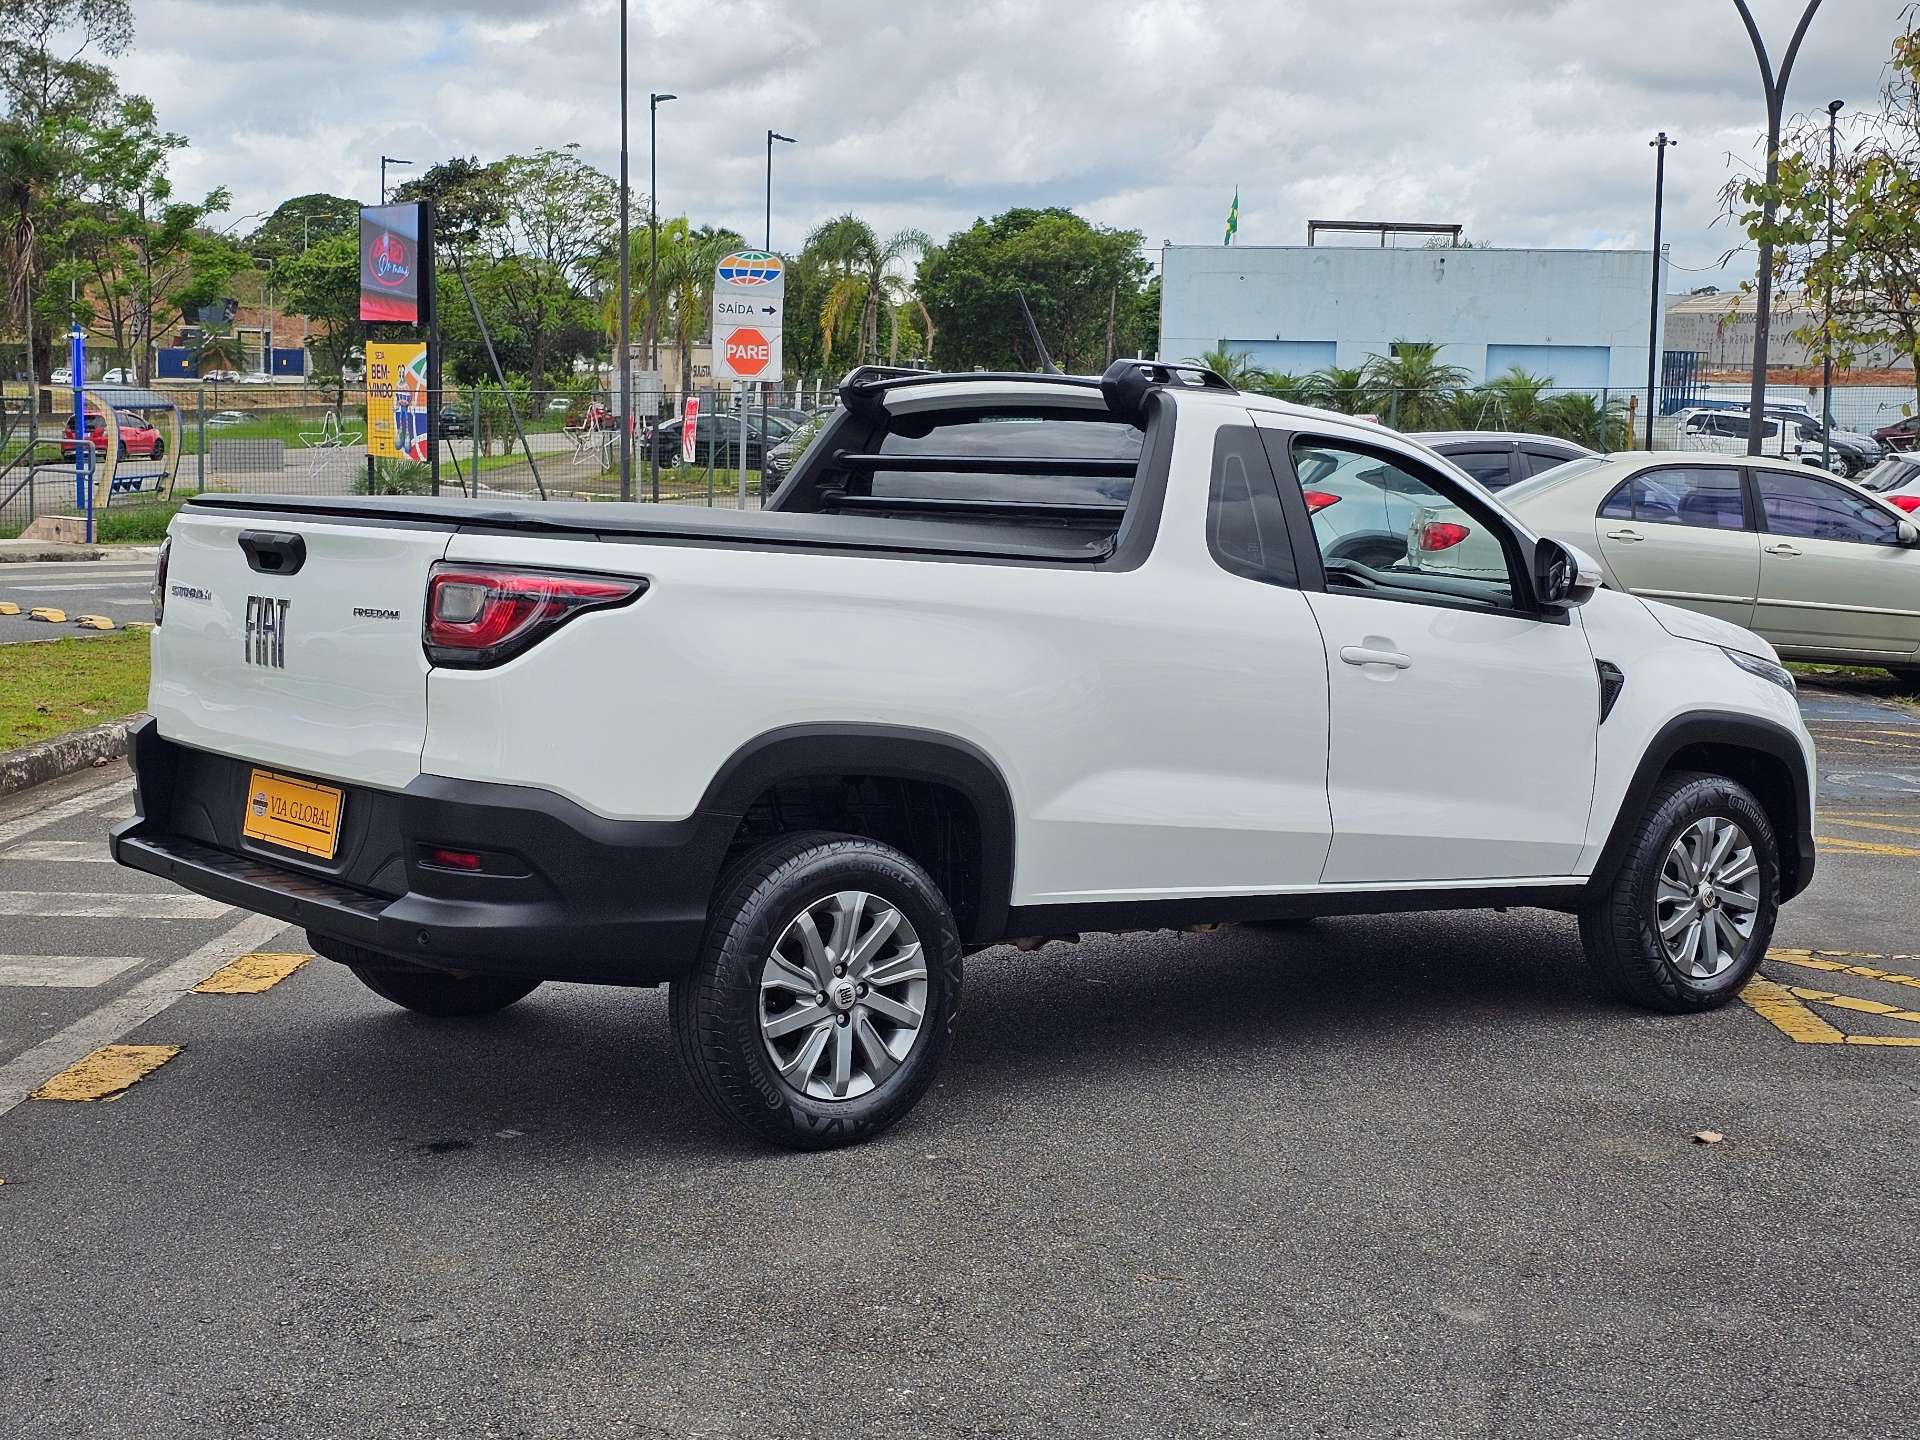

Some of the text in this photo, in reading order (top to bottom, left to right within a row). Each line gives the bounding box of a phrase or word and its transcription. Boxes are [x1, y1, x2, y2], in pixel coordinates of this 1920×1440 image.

[718, 302, 754, 315] SAÍDA
[727, 344, 768, 359] PARE
[371, 363, 390, 380] BEM-
[369, 382, 393, 399] VINDO
[353, 607, 400, 620] FREEDOM
[245, 595, 291, 669] FIAT
[271, 797, 331, 828] VIA GLOBAL
[1729, 794, 1771, 841] Continental
[840, 986, 852, 1005] FIAT
